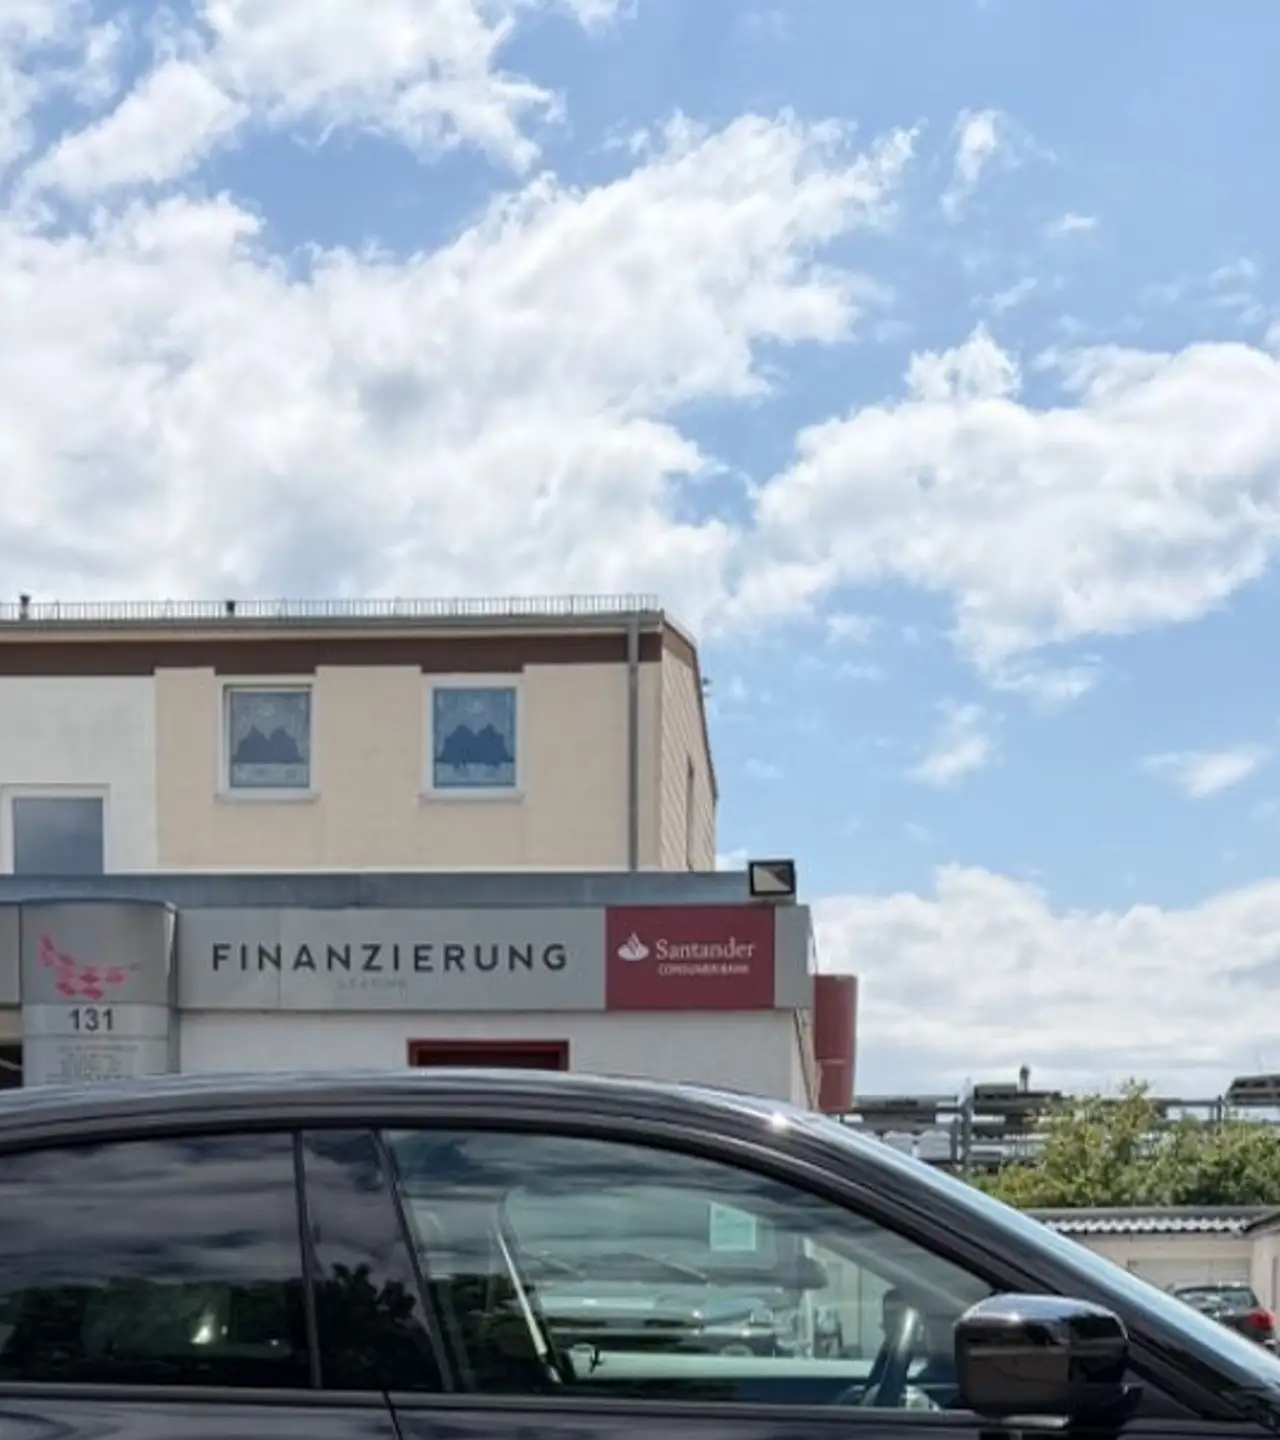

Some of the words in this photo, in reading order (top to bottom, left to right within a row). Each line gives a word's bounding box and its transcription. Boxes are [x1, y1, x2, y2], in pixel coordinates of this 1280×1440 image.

[212, 943, 568, 973] FINANZIERUNG
[655, 936, 755, 960] Santander
[70, 1008, 113, 1032] 131
